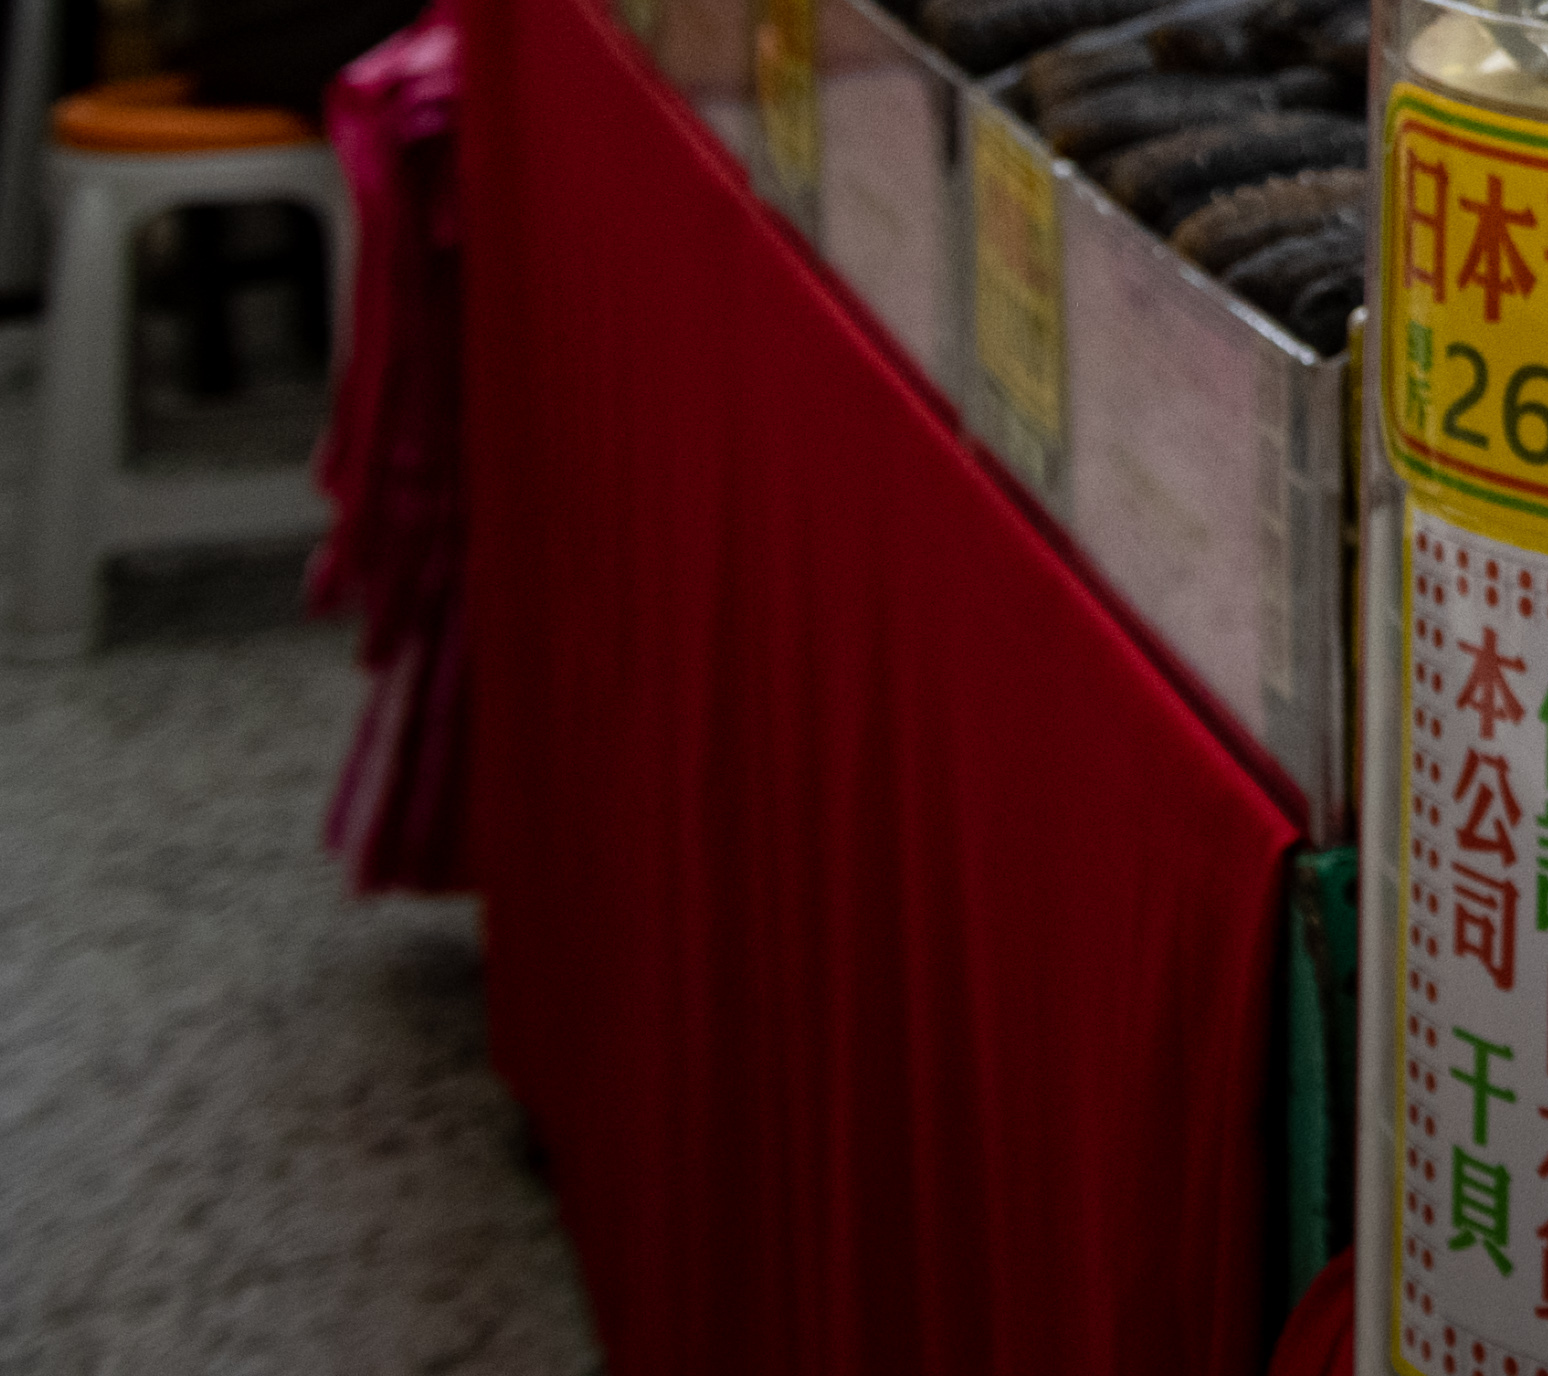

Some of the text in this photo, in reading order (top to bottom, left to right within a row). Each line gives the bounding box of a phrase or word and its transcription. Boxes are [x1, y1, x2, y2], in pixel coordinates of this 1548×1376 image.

[1447, 627, 1526, 1278] 本公司 干貝
